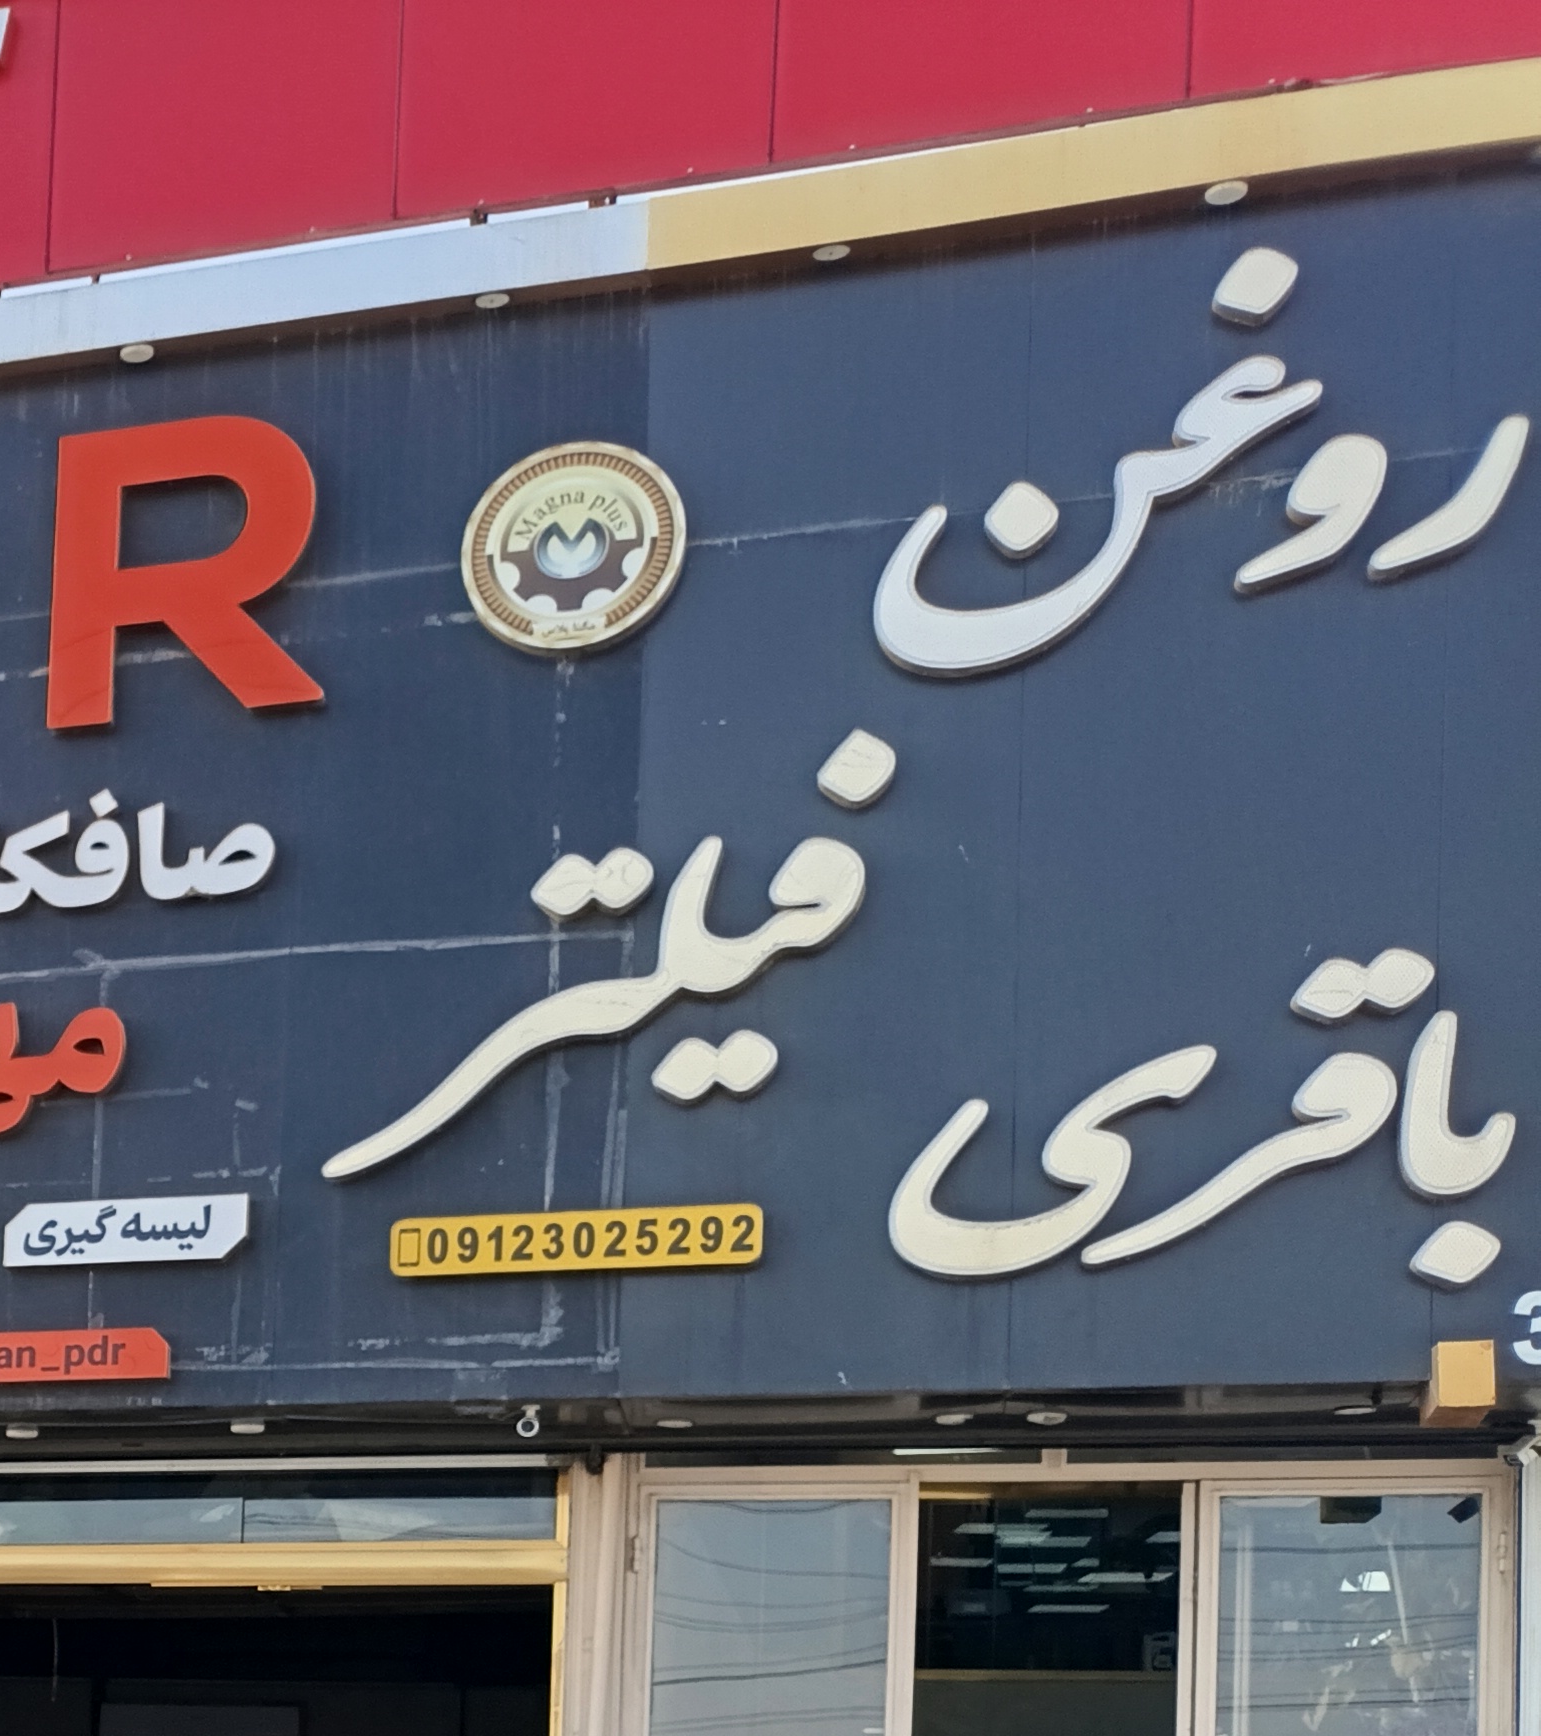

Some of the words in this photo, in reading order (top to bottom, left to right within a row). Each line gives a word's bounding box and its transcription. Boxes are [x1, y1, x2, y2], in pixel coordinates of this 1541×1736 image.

[874, 247, 1529, 678] روغن
[514, 489, 586, 541] Magna
[588, 492, 629, 533] plus
[323, 727, 897, 1180] فیلتر
[888, 948, 1517, 1290] باقری
[23, 1204, 117, 1257] گیری
[119, 1204, 212, 1251] لیسه
[426, 1214, 756, 1265] 09123025292
